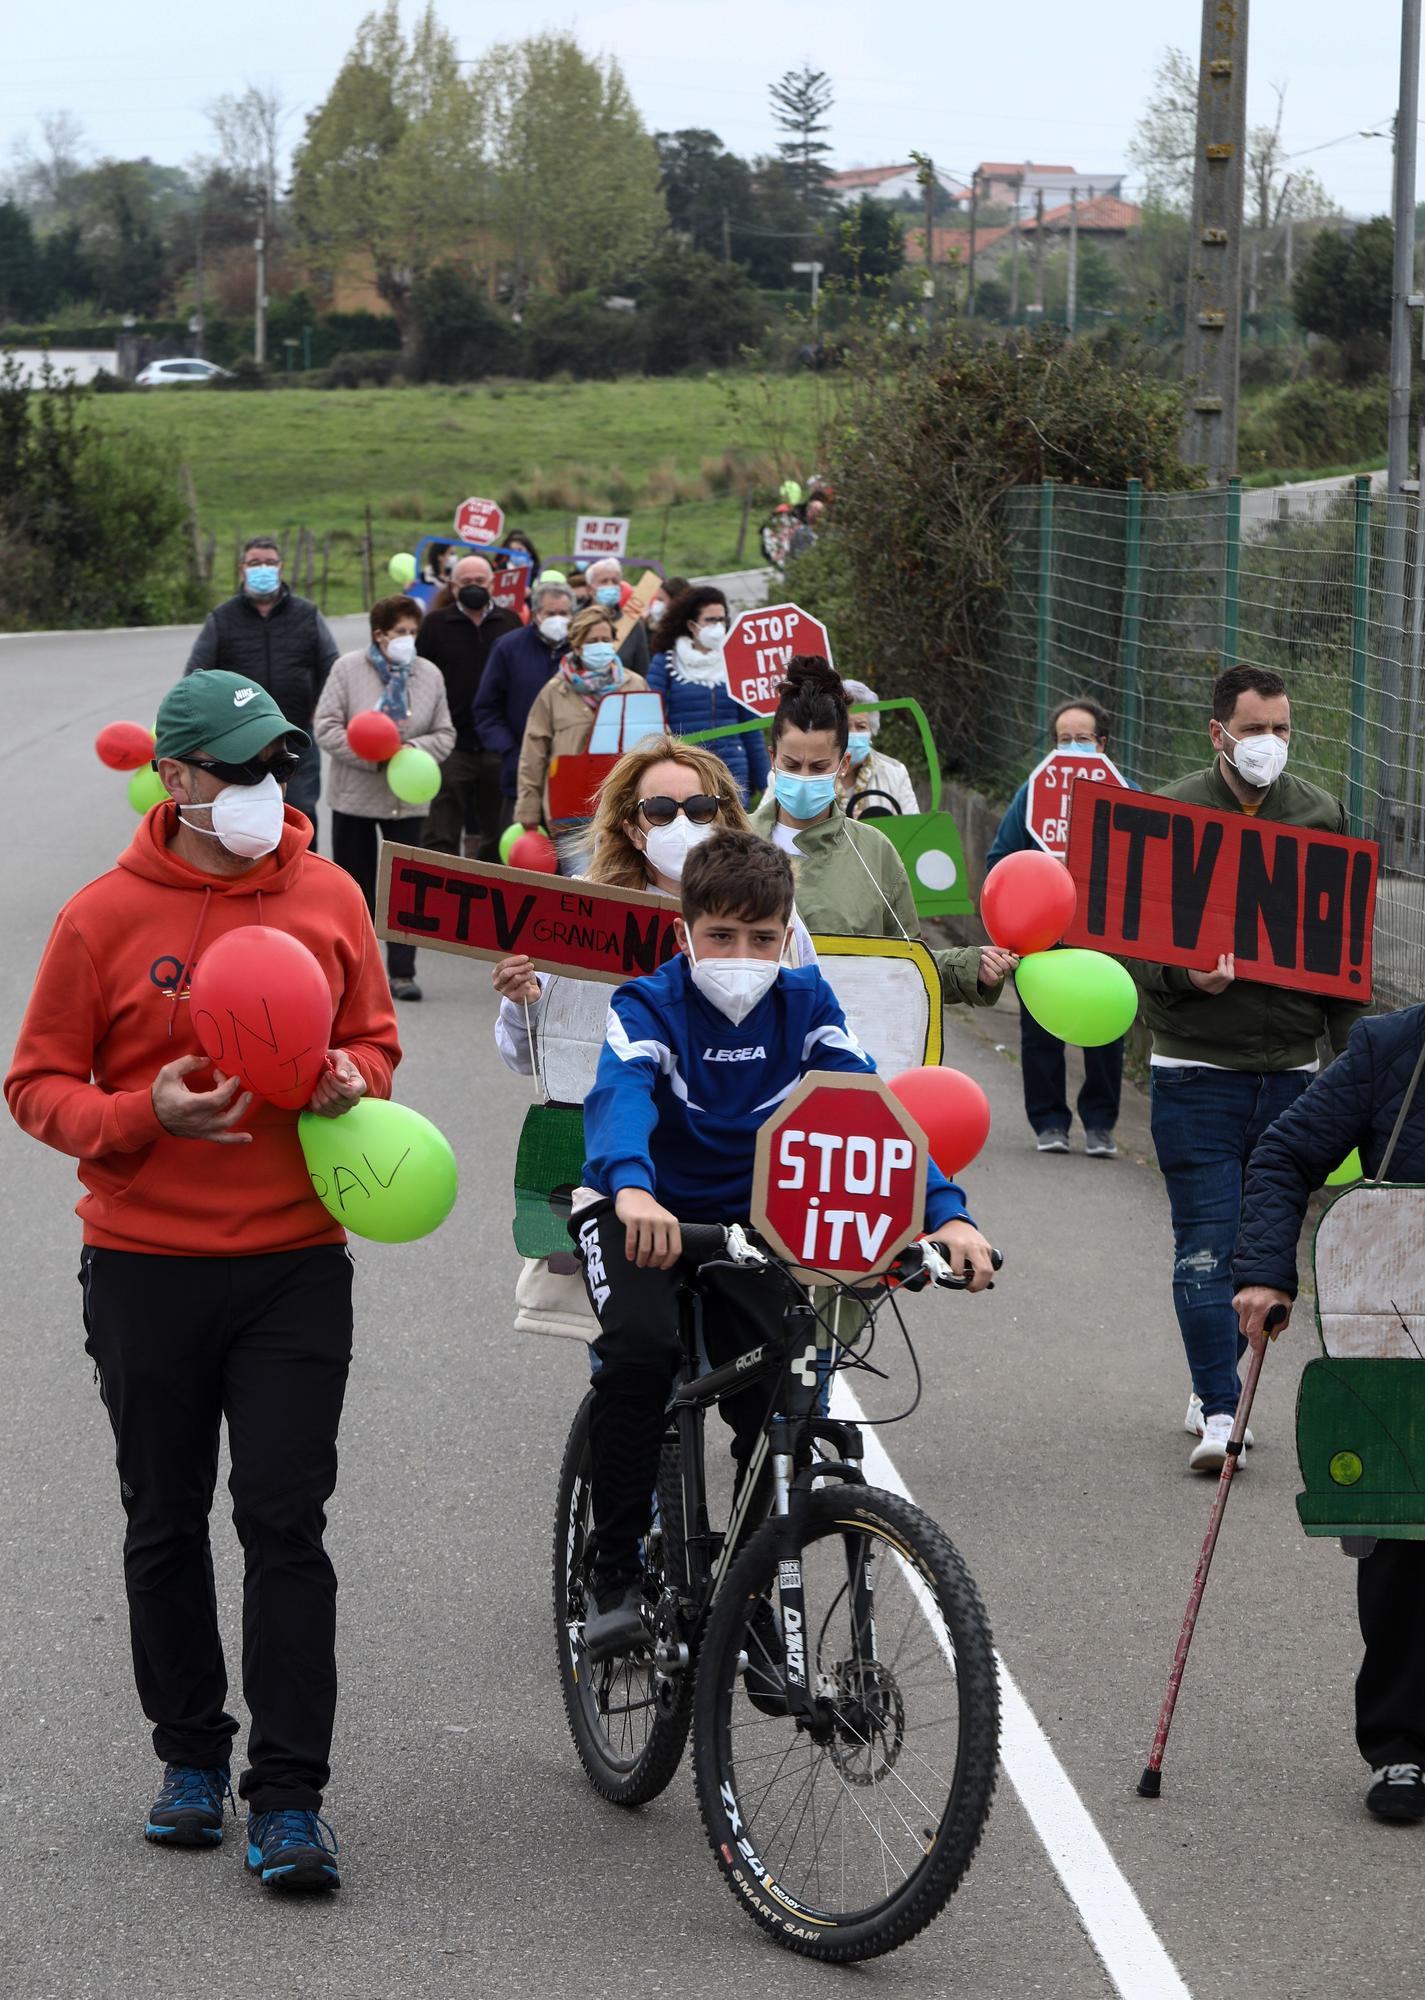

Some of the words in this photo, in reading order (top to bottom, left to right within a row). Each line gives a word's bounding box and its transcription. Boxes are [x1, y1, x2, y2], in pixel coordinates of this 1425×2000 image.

[585, 522, 598, 534] NO
[603, 522, 622, 534] ITV
[501, 571, 520, 587] ITV
[742, 613, 800, 645] STOP
[756, 645, 793, 674] ITV
[234, 688, 254, 701] NIKE
[1087, 799, 1224, 950] ITV
[1234, 829, 1372, 984] NO!
[397, 869, 537, 950] ITV
[561, 893, 593, 918] EN
[533, 919, 621, 956] GRANDA
[703, 1046, 767, 1063] LEGEA
[778, 1129, 914, 1197] STOP
[735, 1346, 763, 1372] ACID
[732, 1868, 783, 1923] SMART
[783, 1922, 821, 1942] SAM
[771, 1884, 801, 1909] READY
